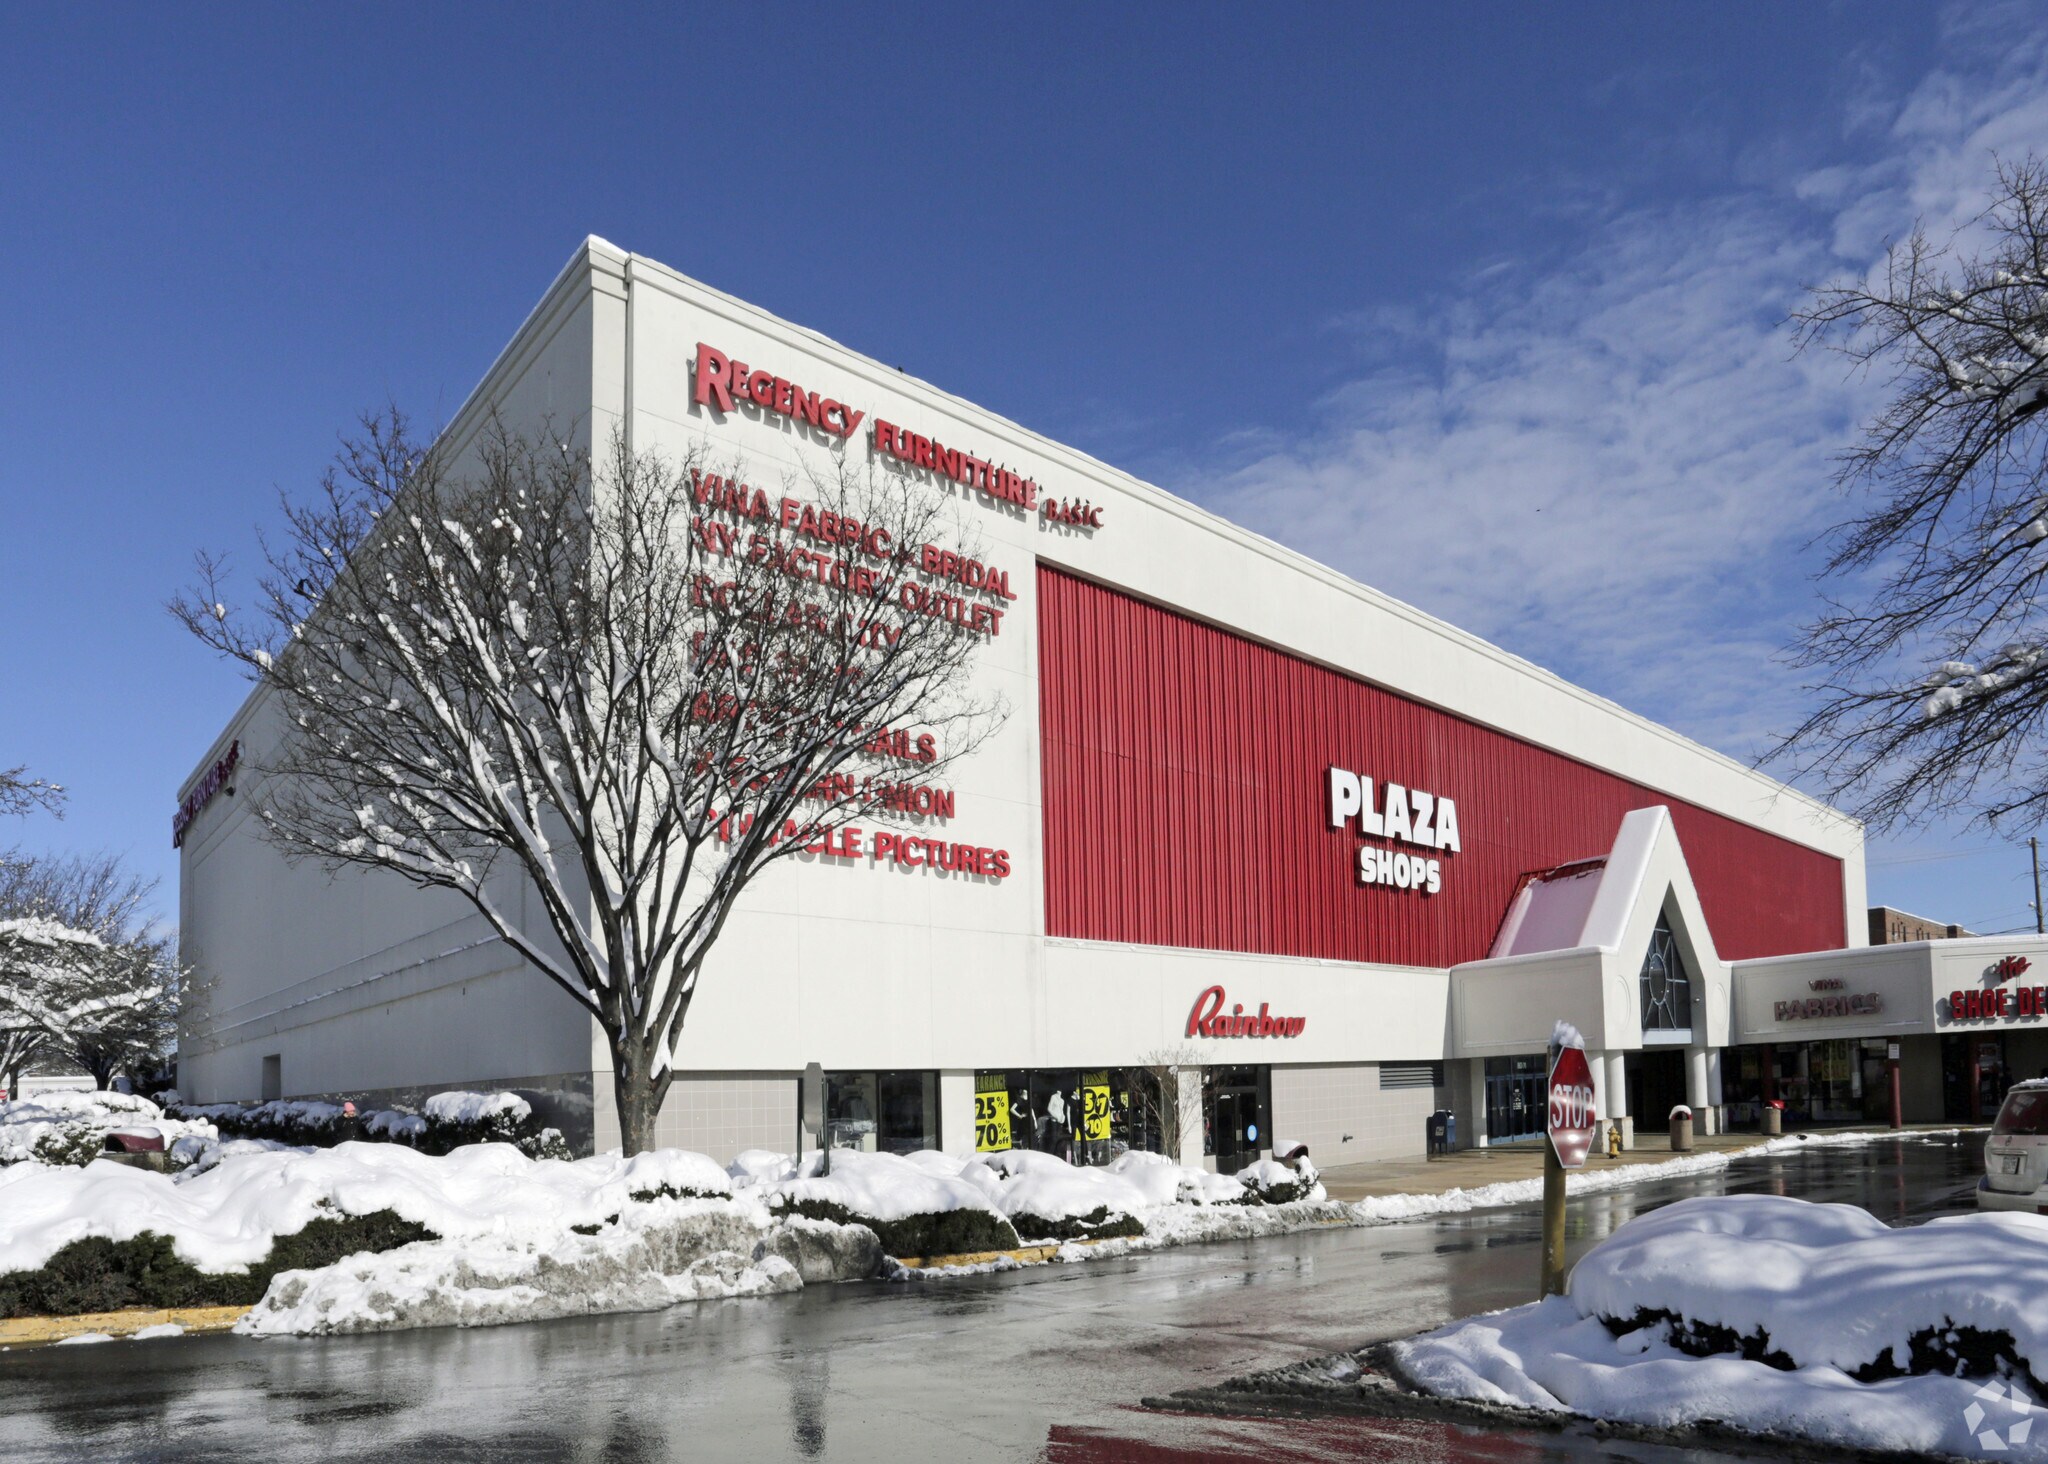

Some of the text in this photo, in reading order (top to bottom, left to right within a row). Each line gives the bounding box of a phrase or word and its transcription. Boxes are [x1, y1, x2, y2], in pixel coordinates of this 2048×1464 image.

[694, 341, 1105, 530] REGENCY FURNITURE BASIC
[691, 468, 771, 524] VINA
[780, 497, 892, 559] FABRIC
[921, 543, 1018, 600] BRIDAL
[692, 516, 1005, 637] NY FACTOR OUTLET
[1328, 766, 1461, 853] PLAZA
[702, 807, 1011, 879] INACLE PICTURES
[1358, 846, 1441, 894] SHOPS
[1808, 978, 1844, 992] VINA
[1995, 955, 2032, 983] the
[1185, 985, 1306, 1037] Rainbow
[1773, 992, 1882, 1021] FABRICS
[1949, 986, 2048, 1019] SHOE DE
[976, 1096, 1005, 1119] 25%
[1552, 1083, 1593, 1129] STOP
[976, 1122, 1007, 1147] 70%
[998, 1136, 1009, 1145] off
